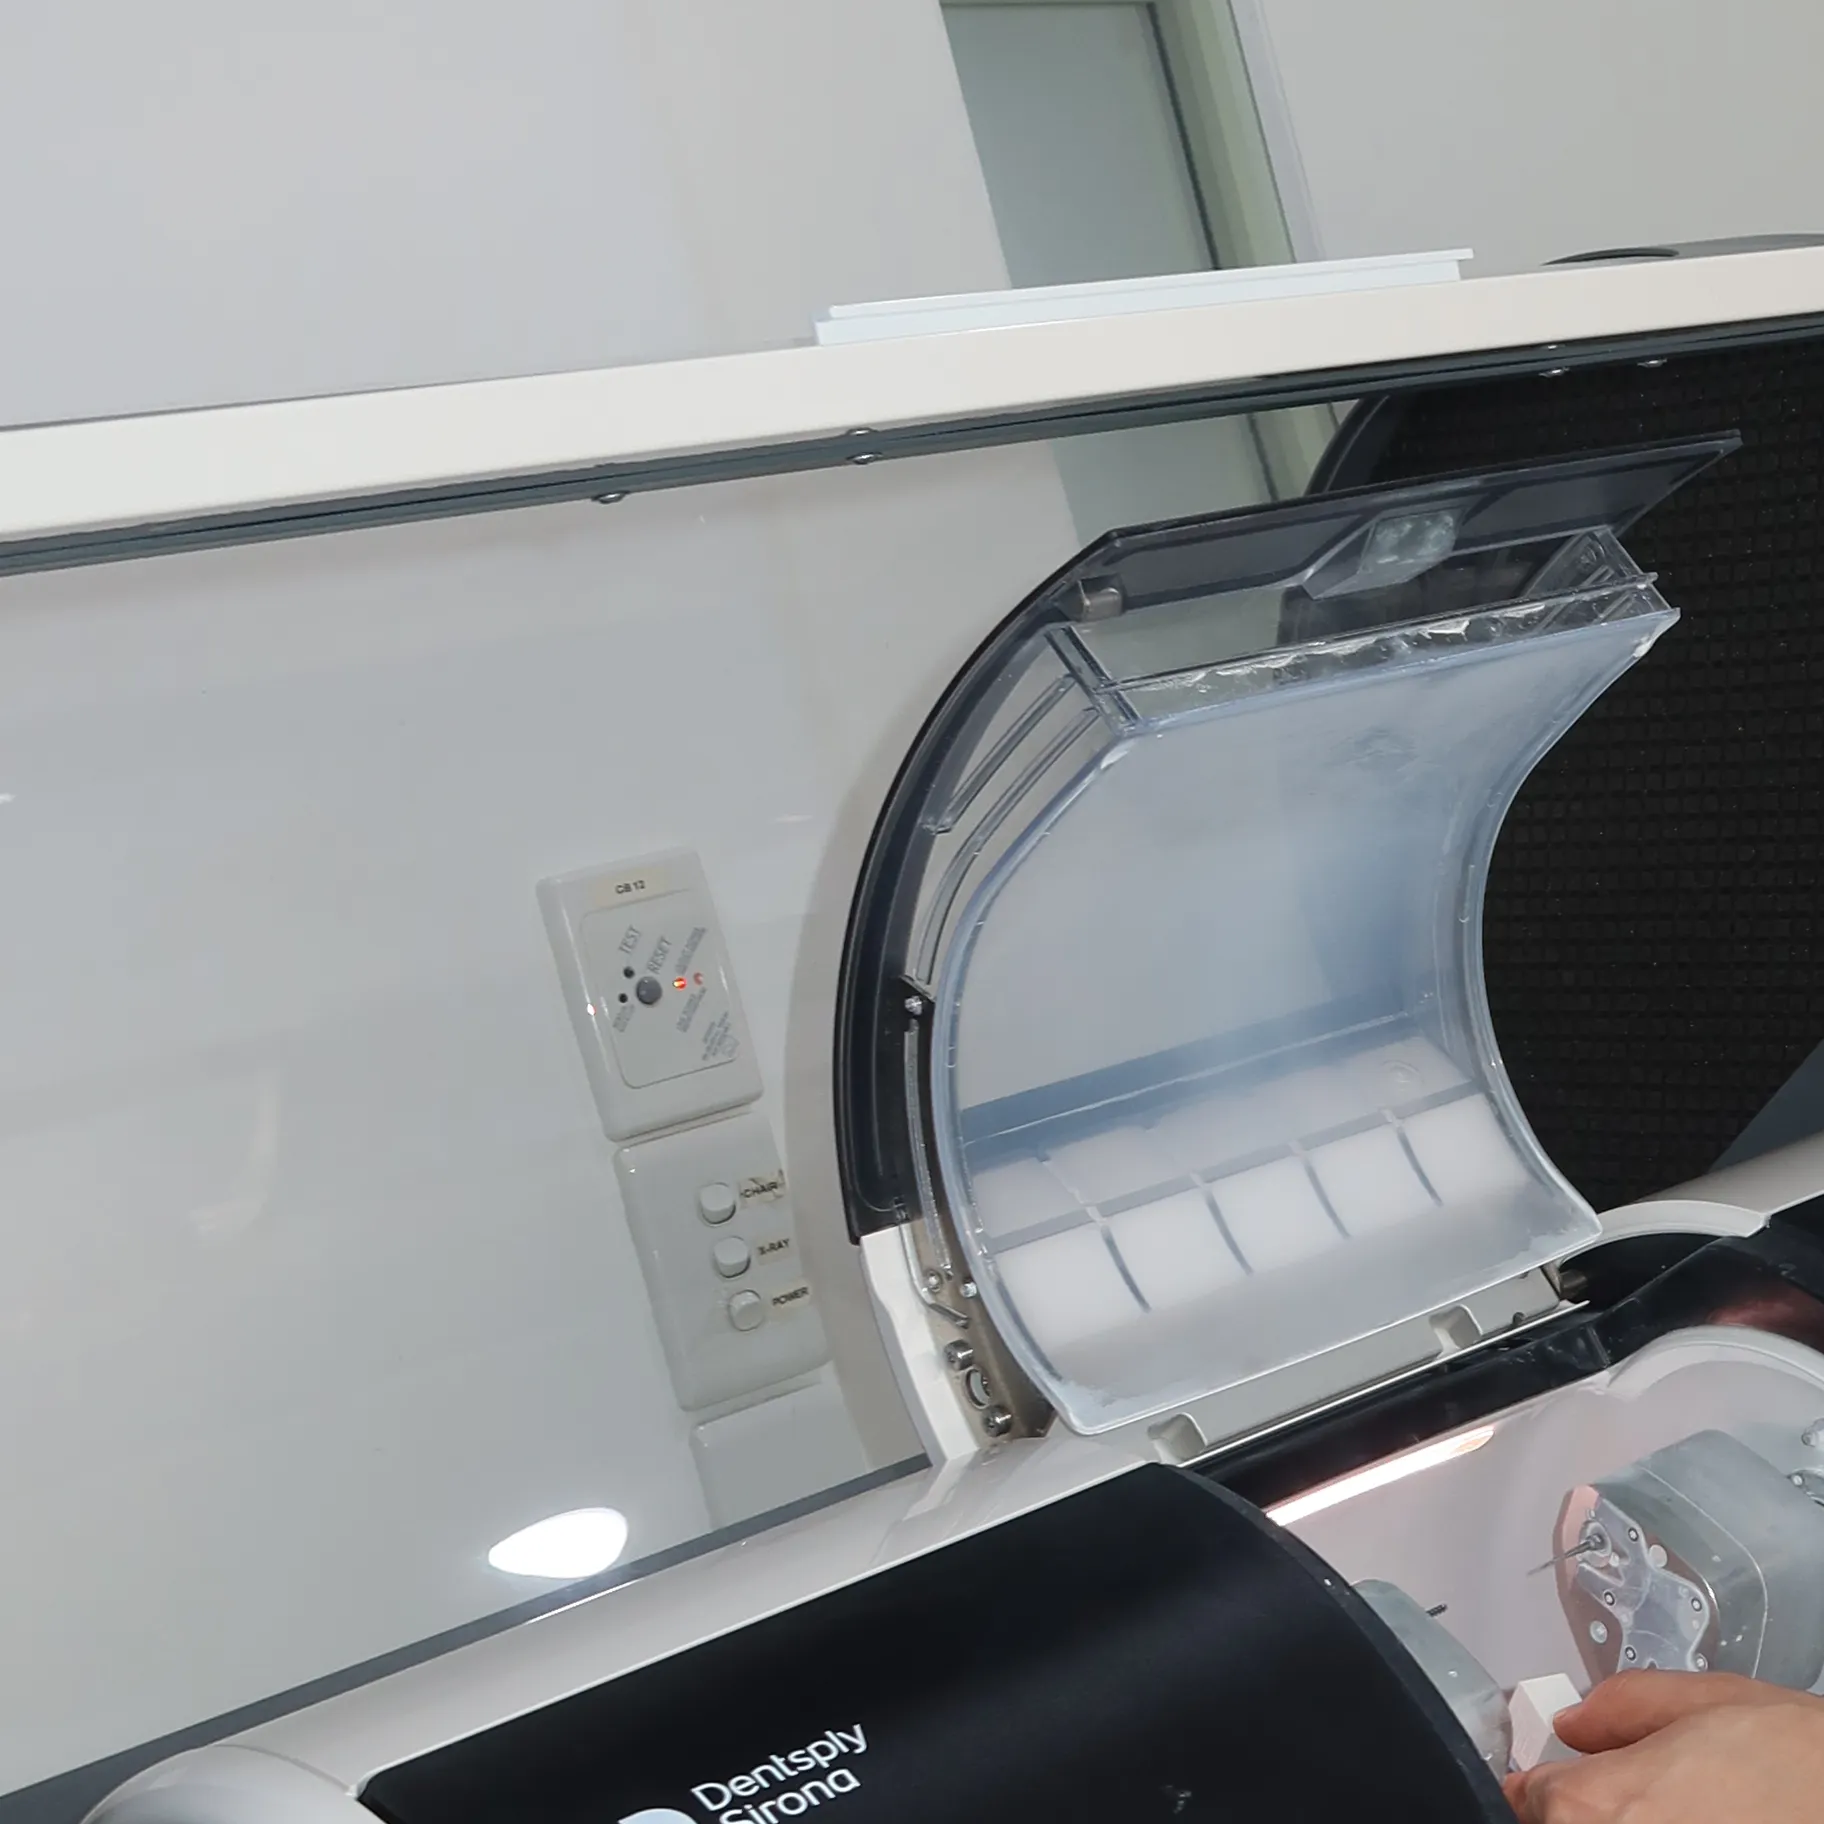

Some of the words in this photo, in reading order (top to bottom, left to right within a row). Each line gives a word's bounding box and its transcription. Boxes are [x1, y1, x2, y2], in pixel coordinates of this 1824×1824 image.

[618, 925, 641, 955] TEST
[647, 936, 672, 975] RESET
[758, 1238, 790, 1255] X-RAY
[772, 1287, 809, 1306] POWER
[690, 1723, 868, 1812] Dentsply
